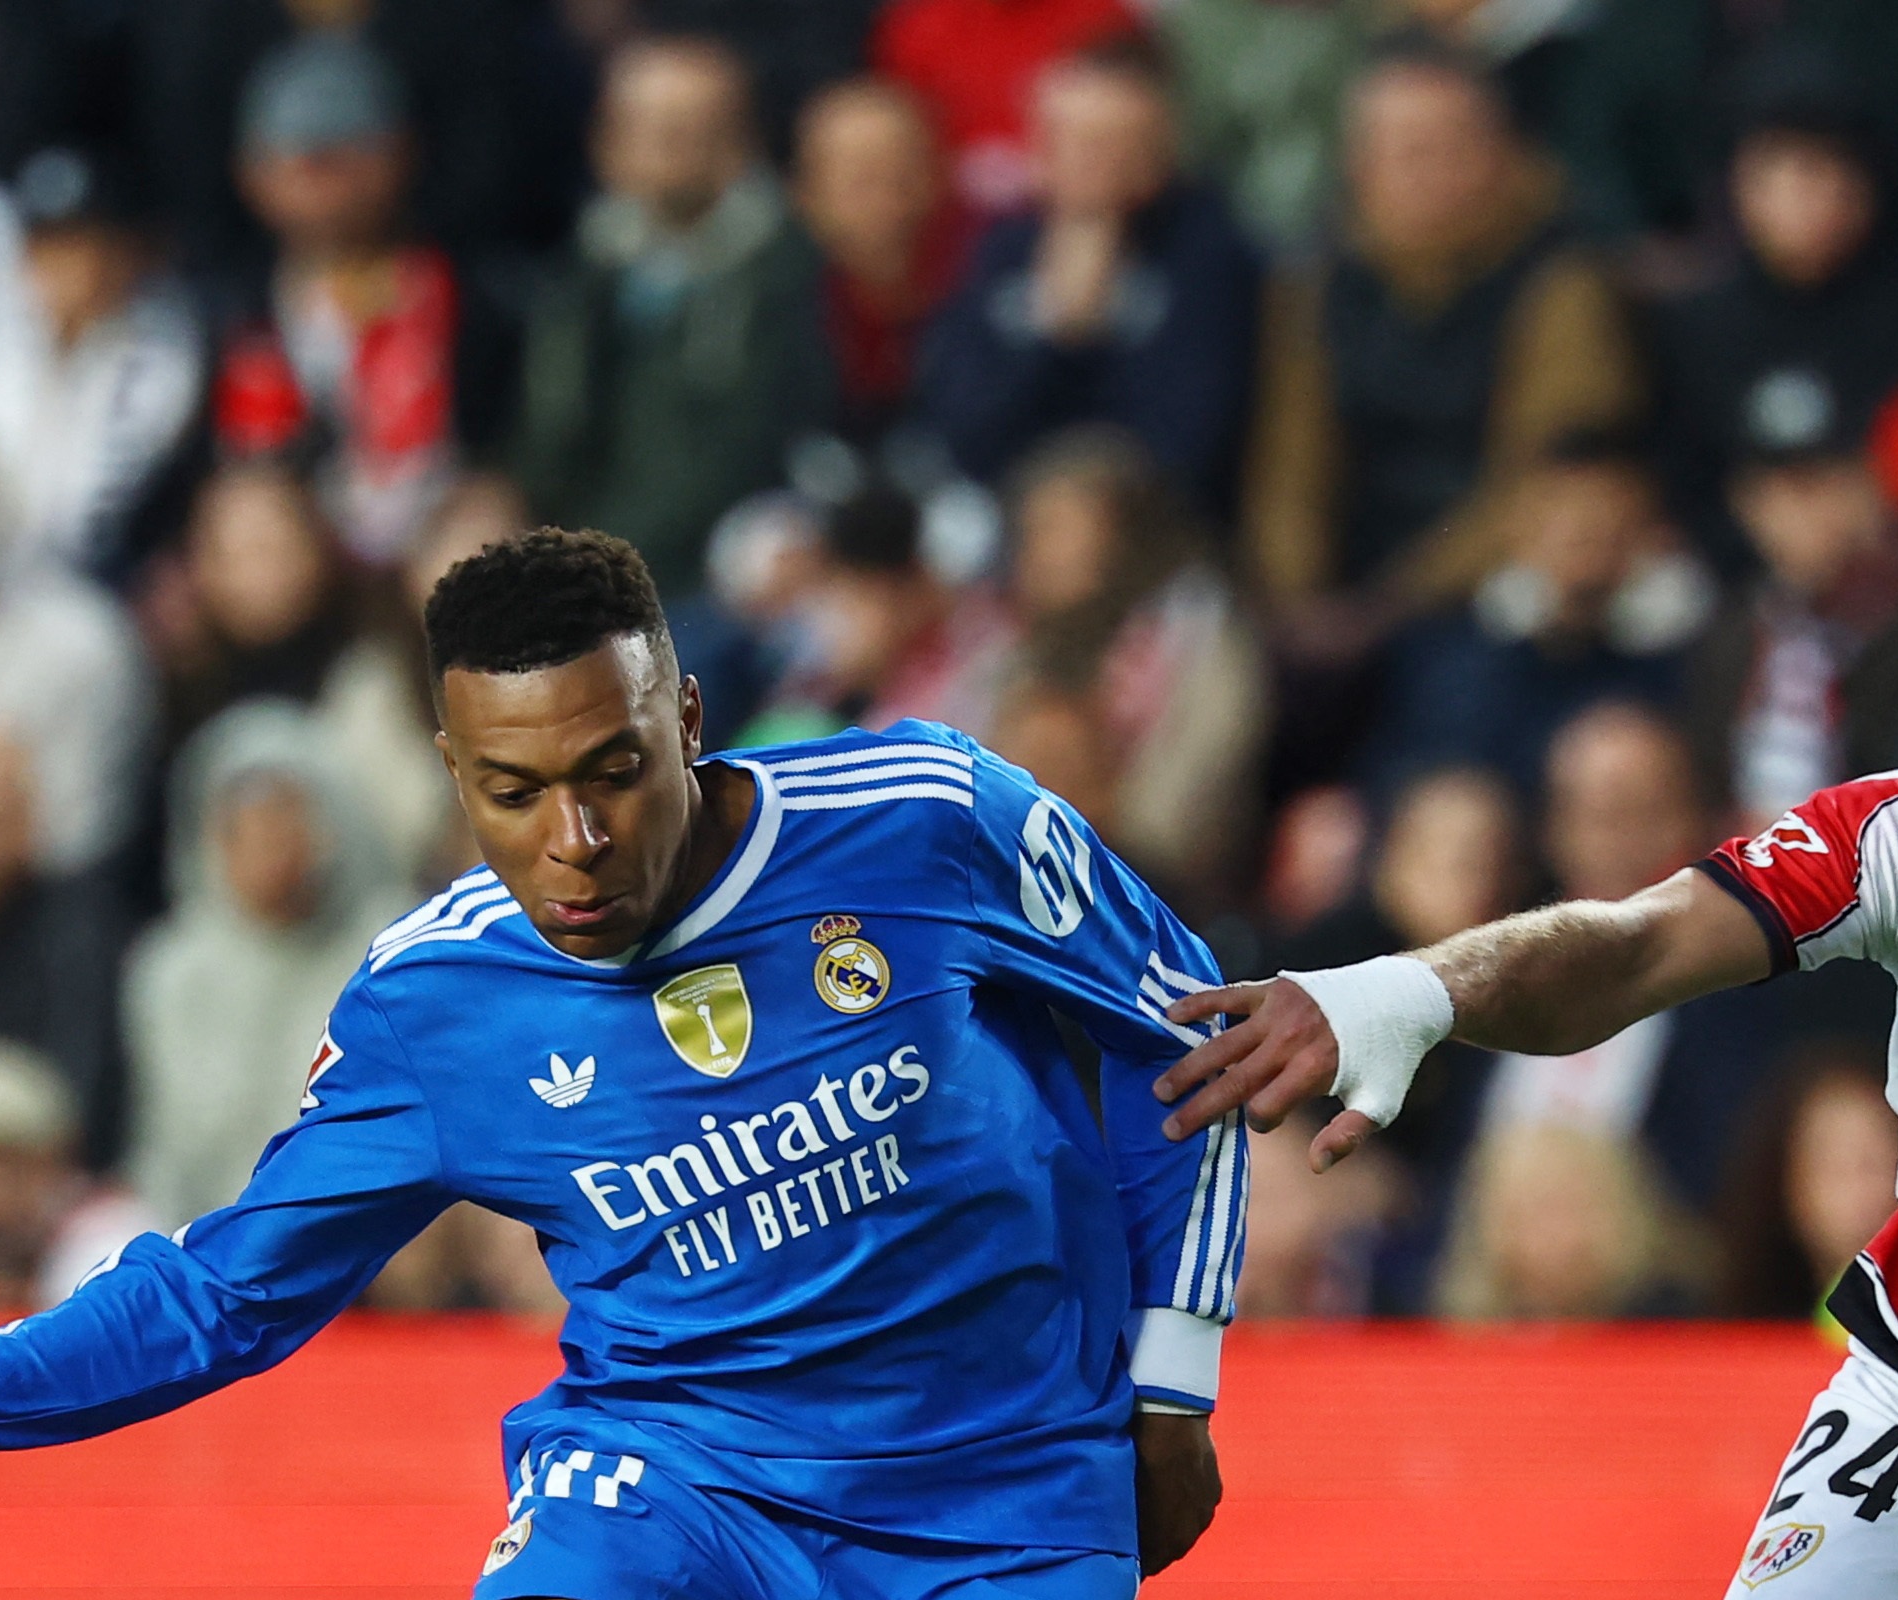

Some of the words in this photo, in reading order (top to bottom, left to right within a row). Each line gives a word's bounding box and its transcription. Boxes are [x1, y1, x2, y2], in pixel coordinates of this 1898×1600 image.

[570, 1045, 930, 1231] Emirates
[664, 1206, 738, 1277] FLY
[746, 1134, 910, 1251] BETTER
